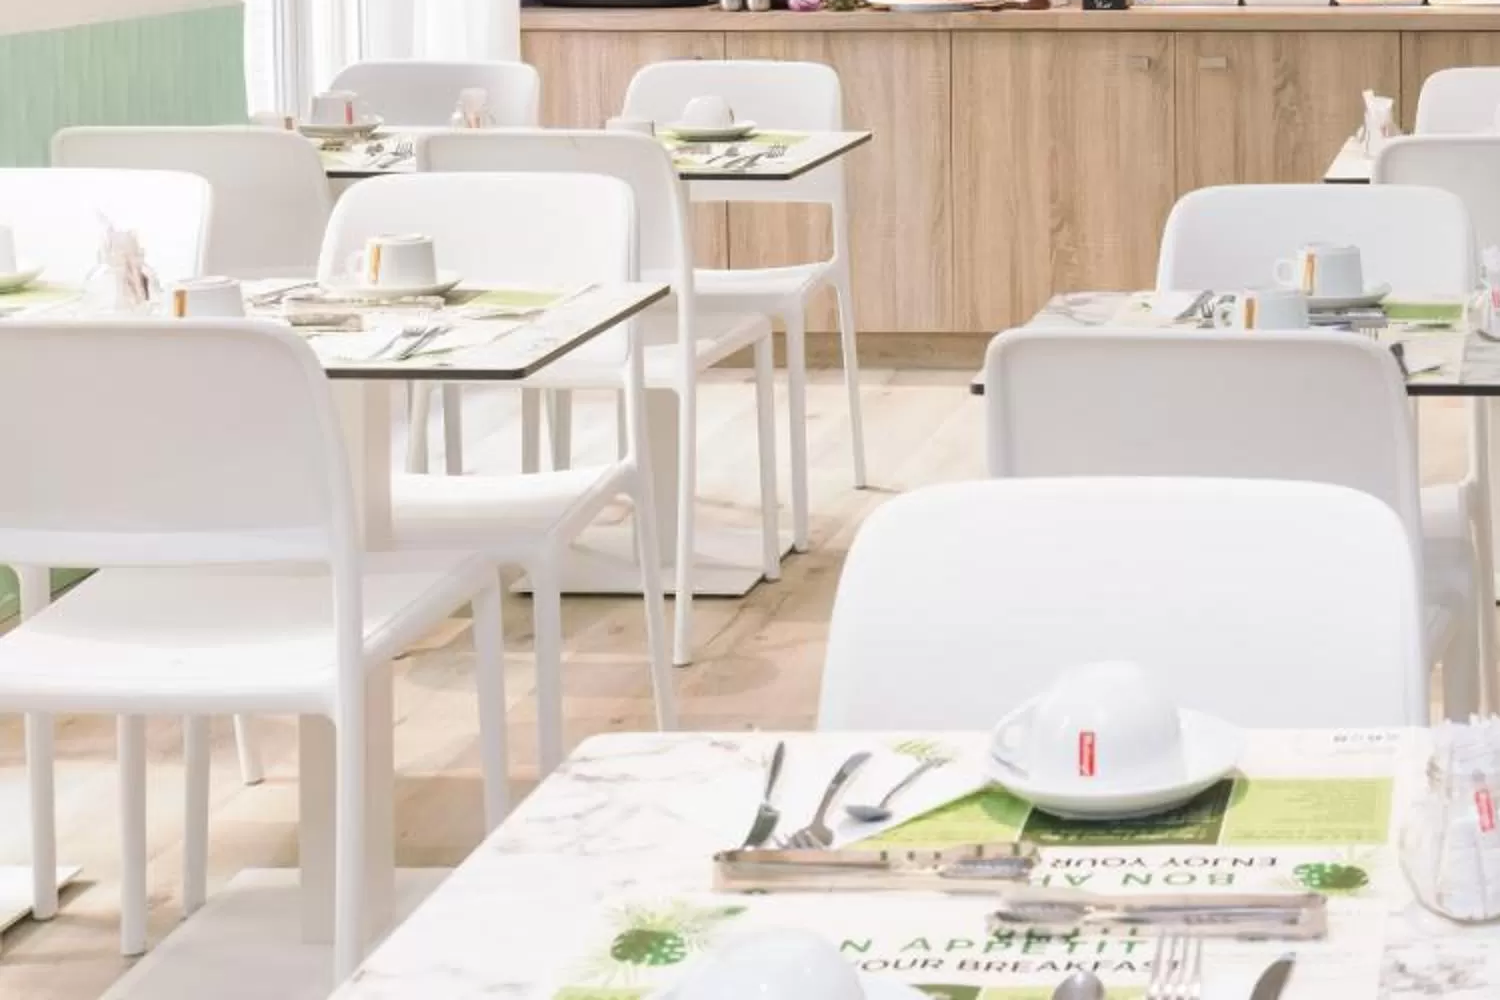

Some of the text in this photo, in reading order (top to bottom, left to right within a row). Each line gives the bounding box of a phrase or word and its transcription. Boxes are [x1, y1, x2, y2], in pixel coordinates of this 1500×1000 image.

[1051, 857, 1277, 868] ENJOY YOUR
[1121, 872, 1236, 886] BON
[900, 937, 1150, 955] APPETIT
[855, 957, 944, 972] OUR
